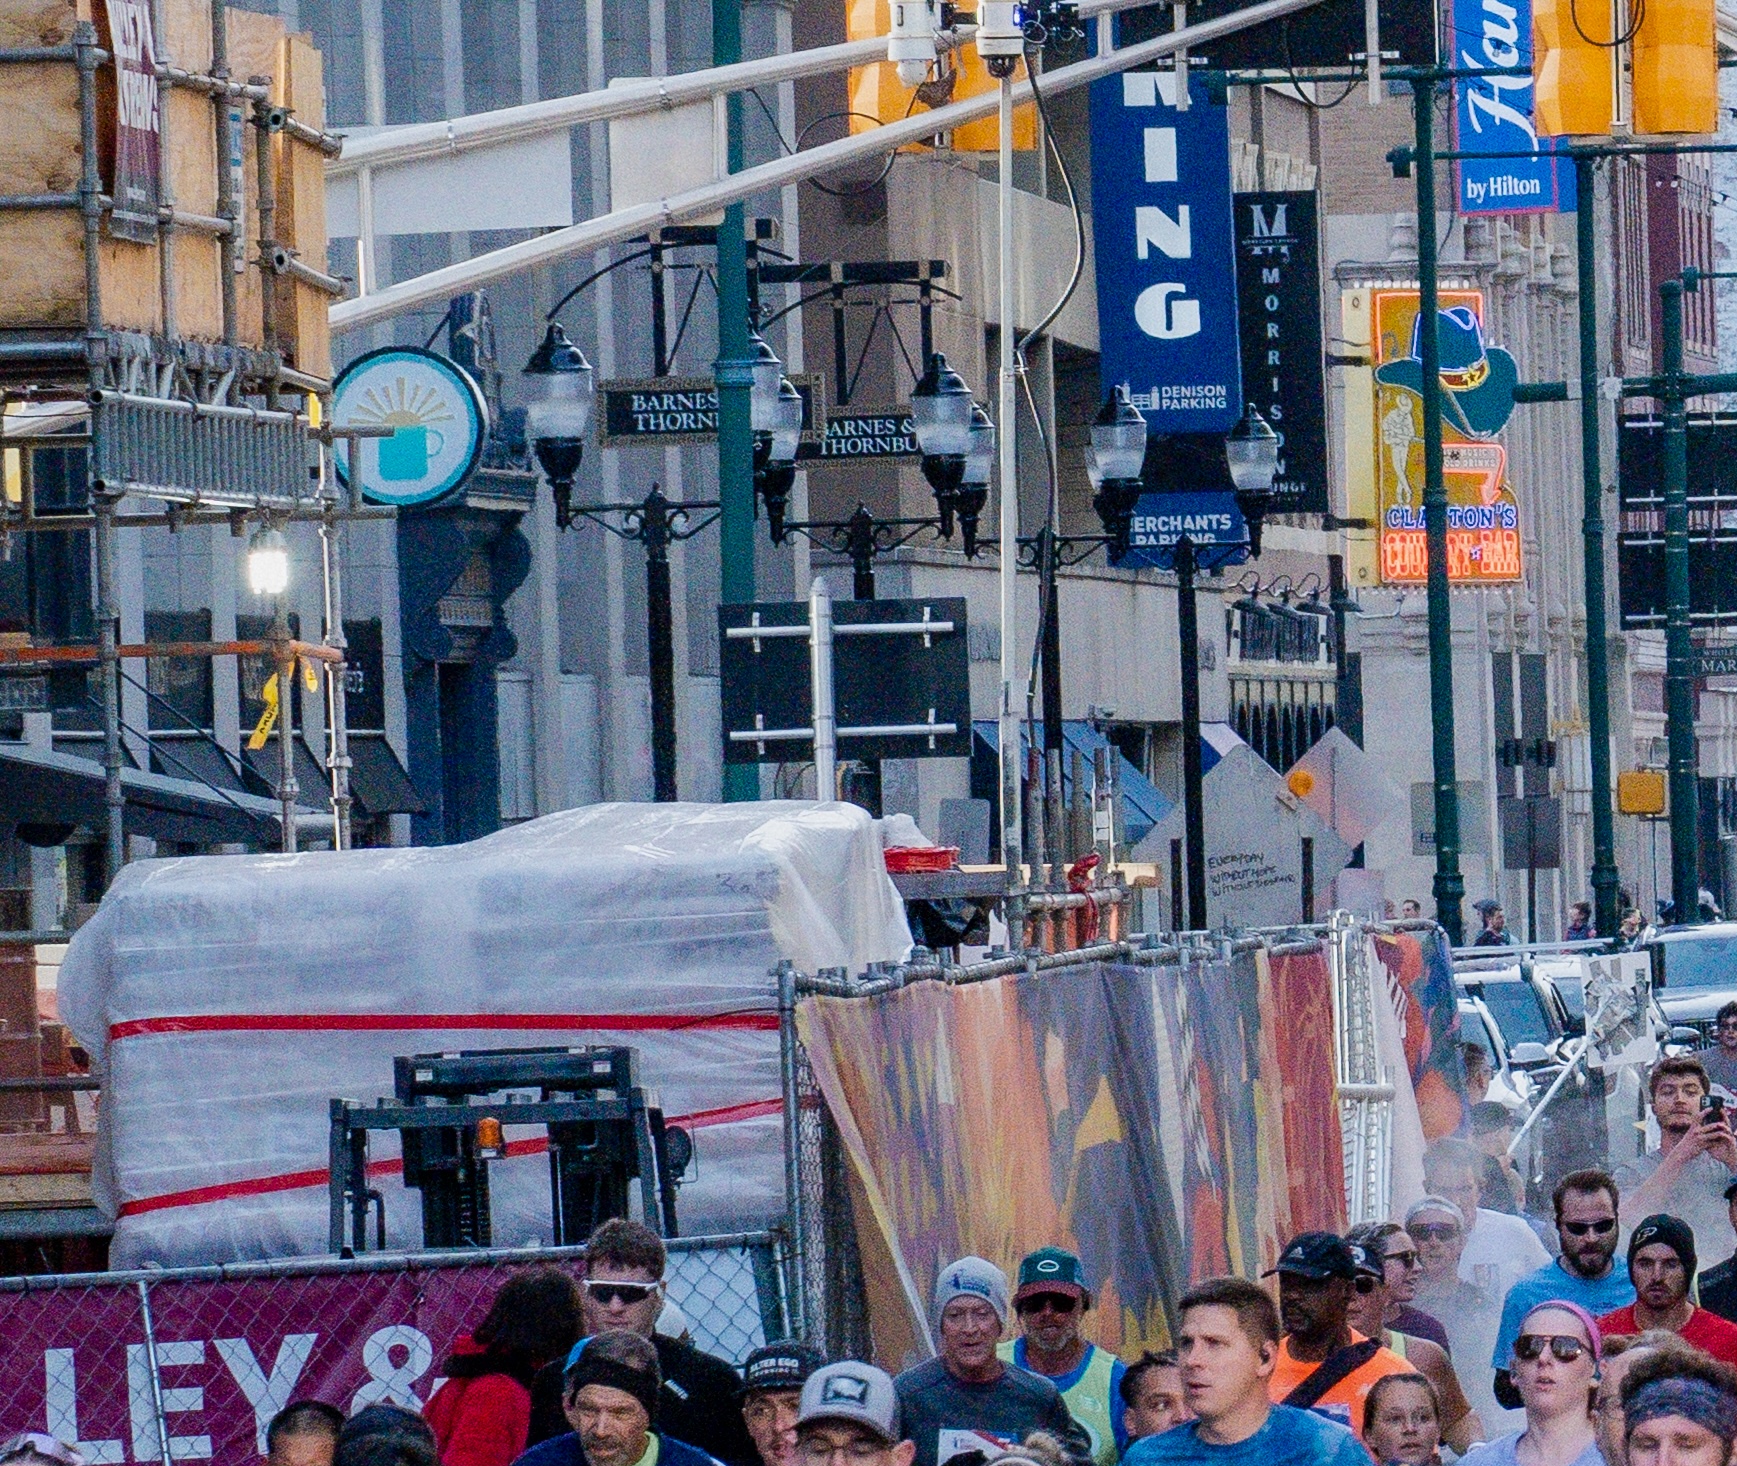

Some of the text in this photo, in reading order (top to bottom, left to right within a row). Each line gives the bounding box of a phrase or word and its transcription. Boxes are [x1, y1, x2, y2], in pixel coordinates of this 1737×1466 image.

[1467, 175, 1541, 204] by Hilton
[1161, 384, 1227, 398] DENISON
[631, 393, 719, 412] BARNES
[1161, 397, 1227, 410] PARKING
[633, 411, 719, 431] THORN
[902, 417, 917, 435] &
[820, 435, 920, 455] THORNBU
[1386, 504, 1517, 529] CLATON'S
[1383, 531, 1472, 578] COURY
